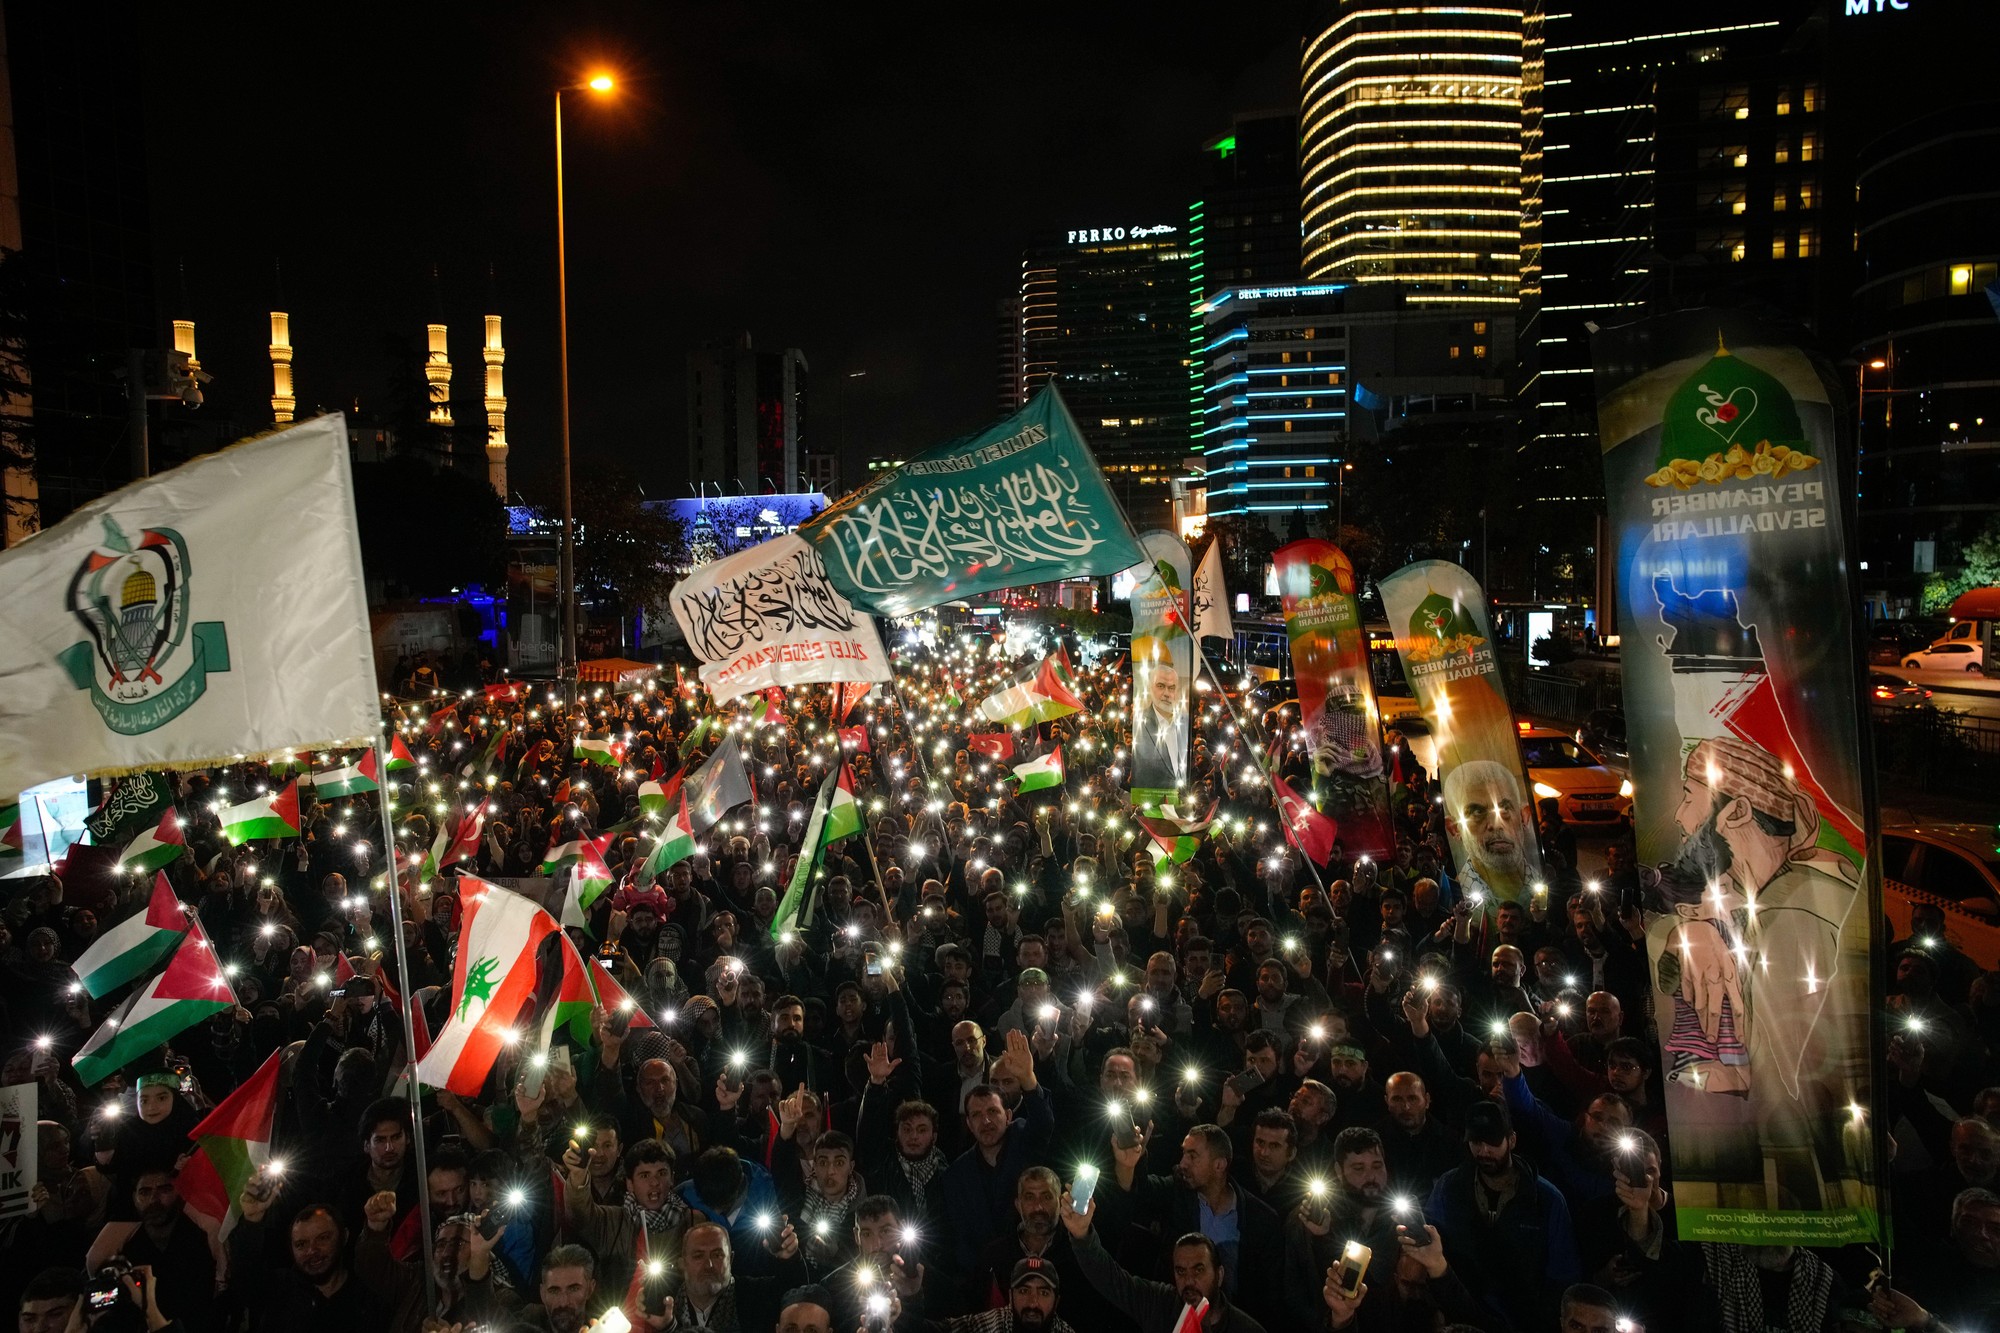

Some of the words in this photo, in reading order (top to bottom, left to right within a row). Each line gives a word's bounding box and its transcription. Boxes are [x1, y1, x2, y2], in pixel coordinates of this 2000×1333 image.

[1067, 226, 1125, 244] FERKO
[1238, 291, 1262, 300] DELTA
[1266, 290, 1297, 298] HOTELS
[520, 562, 547, 574] Taksi
[117, 684, 149, 701] فلسطين
